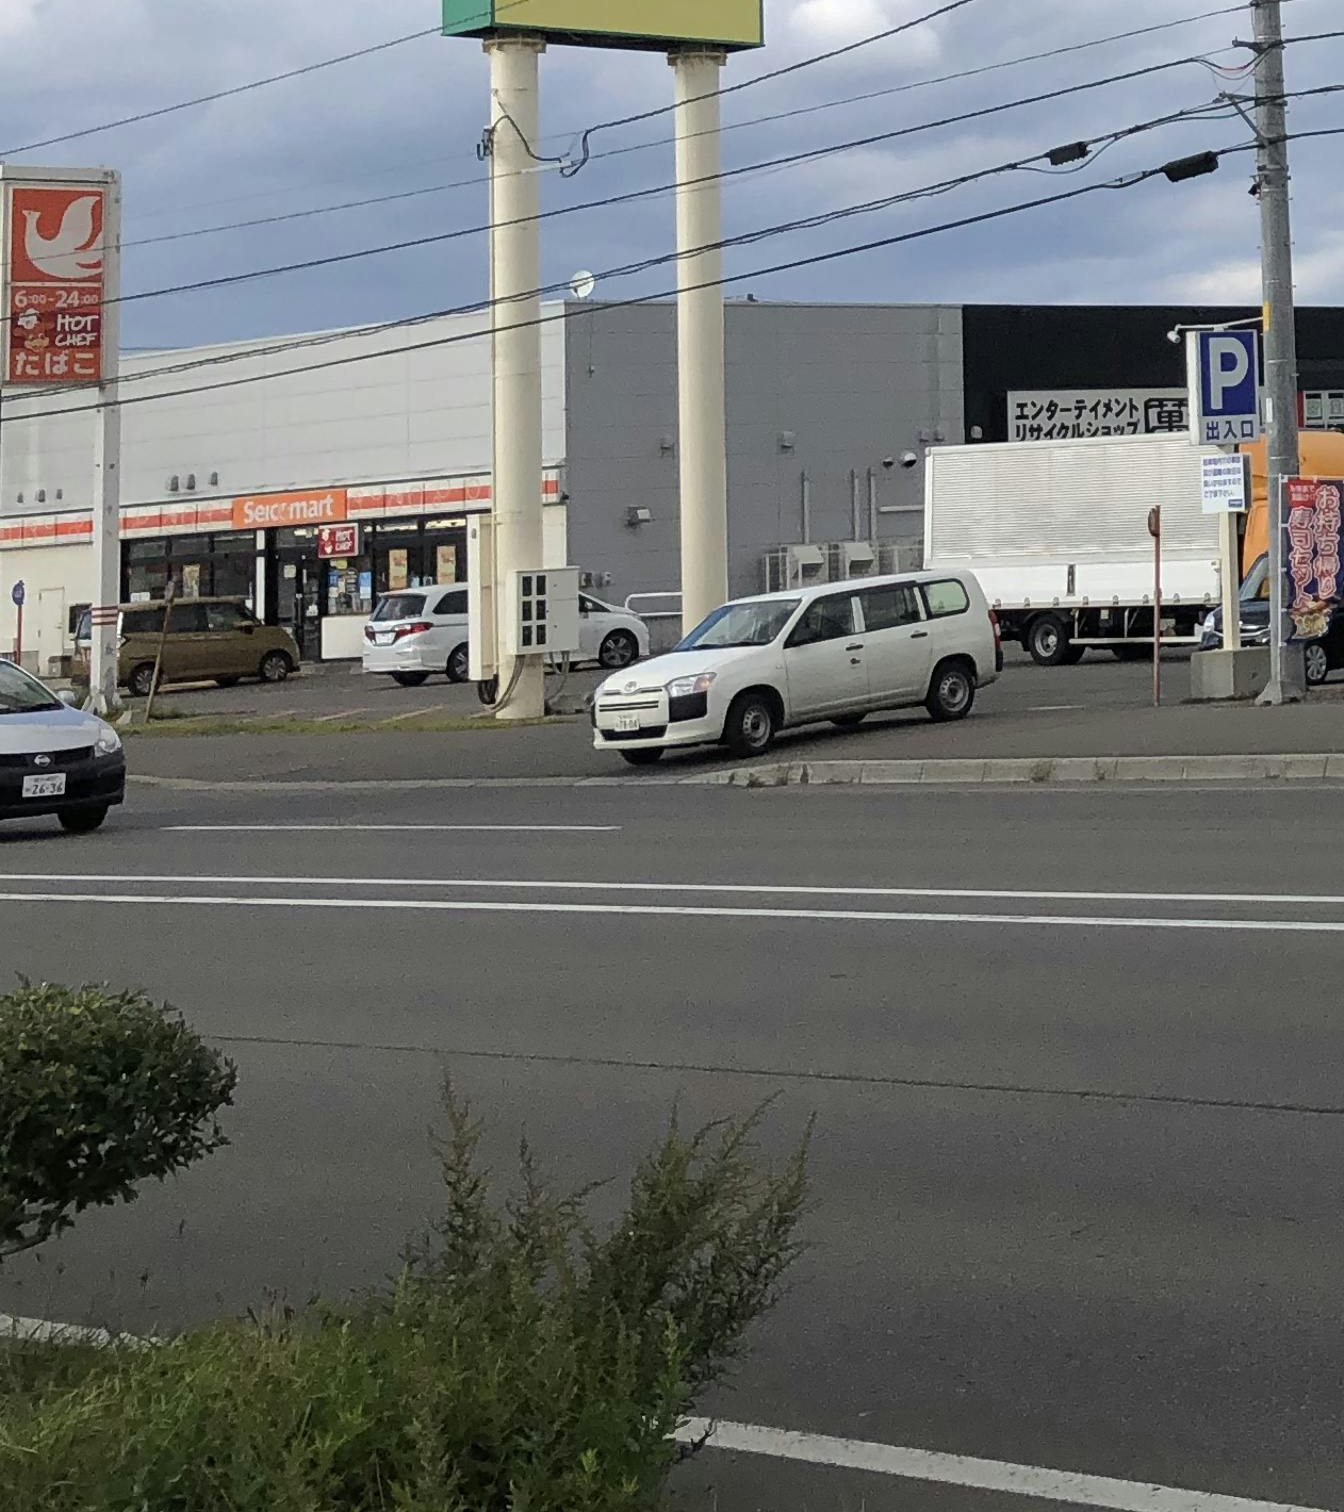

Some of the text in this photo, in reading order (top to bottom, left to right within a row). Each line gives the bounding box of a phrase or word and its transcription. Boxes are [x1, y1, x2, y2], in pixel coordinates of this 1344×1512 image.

[56, 313, 99, 332] HOT
[55, 333, 97, 347] CHEF
[15, 350, 95, 376] たばこ
[1208, 336, 1249, 410] P
[1015, 397, 1139, 421] エンターテイメント
[1206, 420, 1254, 441] 出入口
